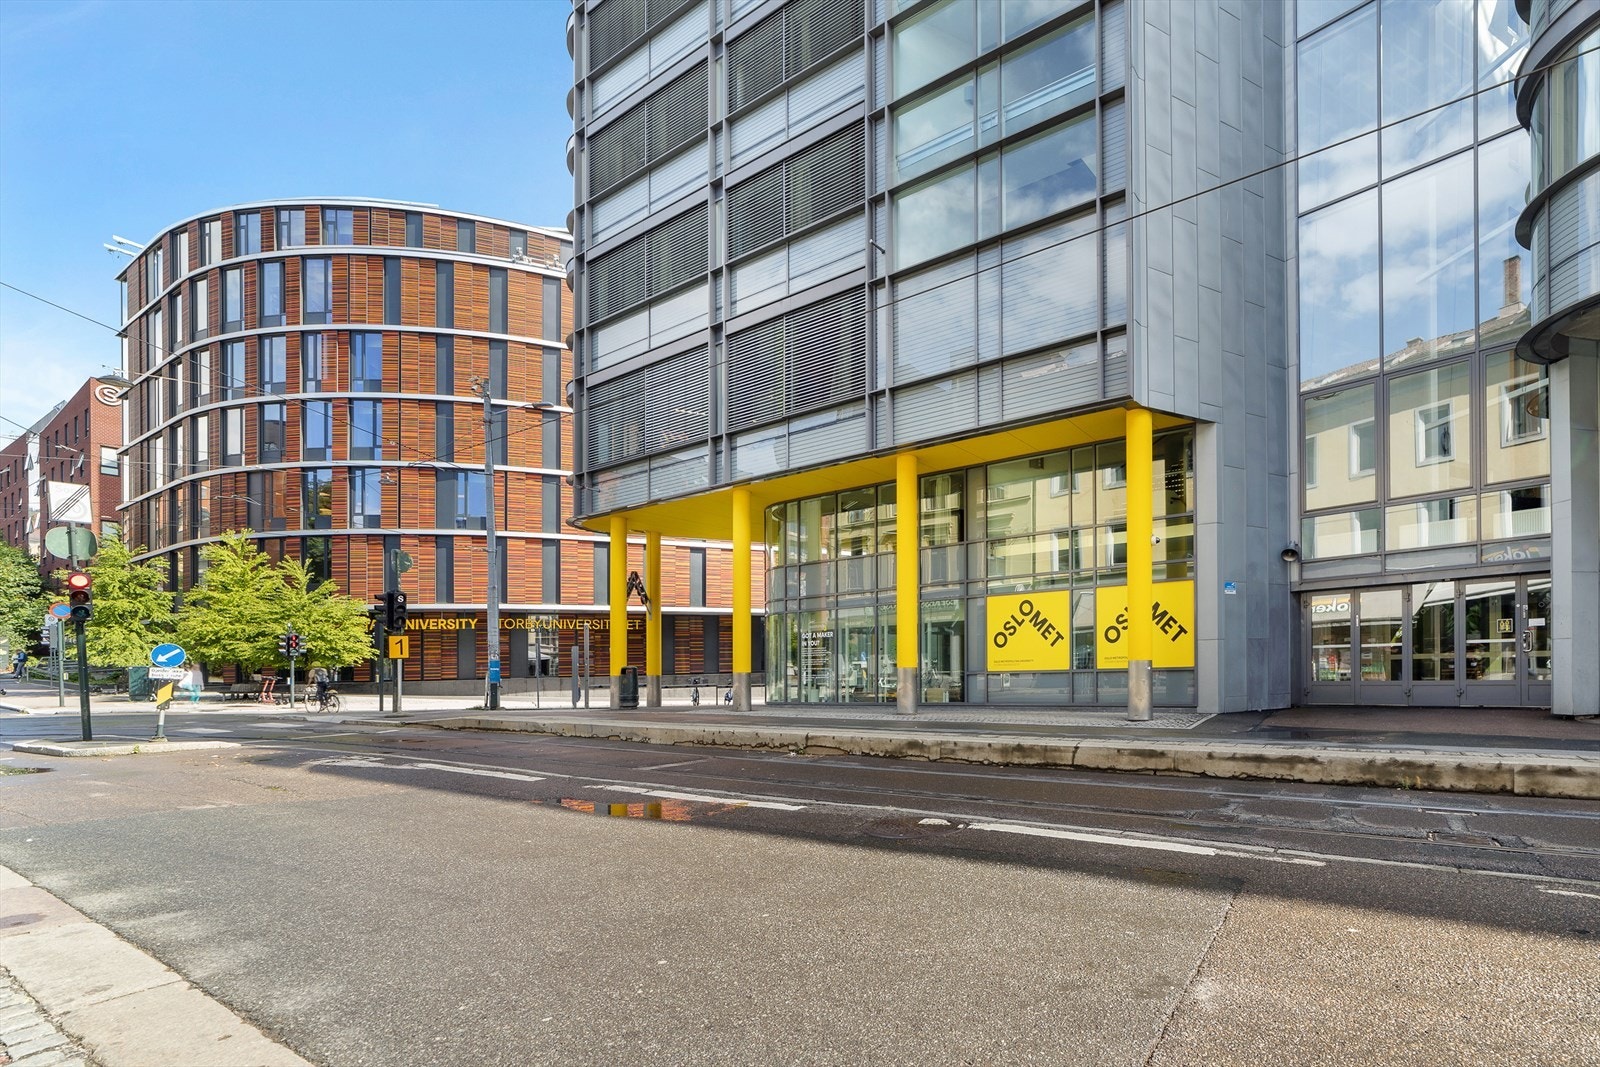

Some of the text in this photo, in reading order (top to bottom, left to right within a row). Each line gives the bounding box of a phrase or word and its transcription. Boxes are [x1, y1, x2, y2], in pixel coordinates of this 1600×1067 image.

[404, 618, 478, 630] NIVERSITY
[1104, 601, 1188, 643] OSMET
[395, 638, 403, 656] 1
